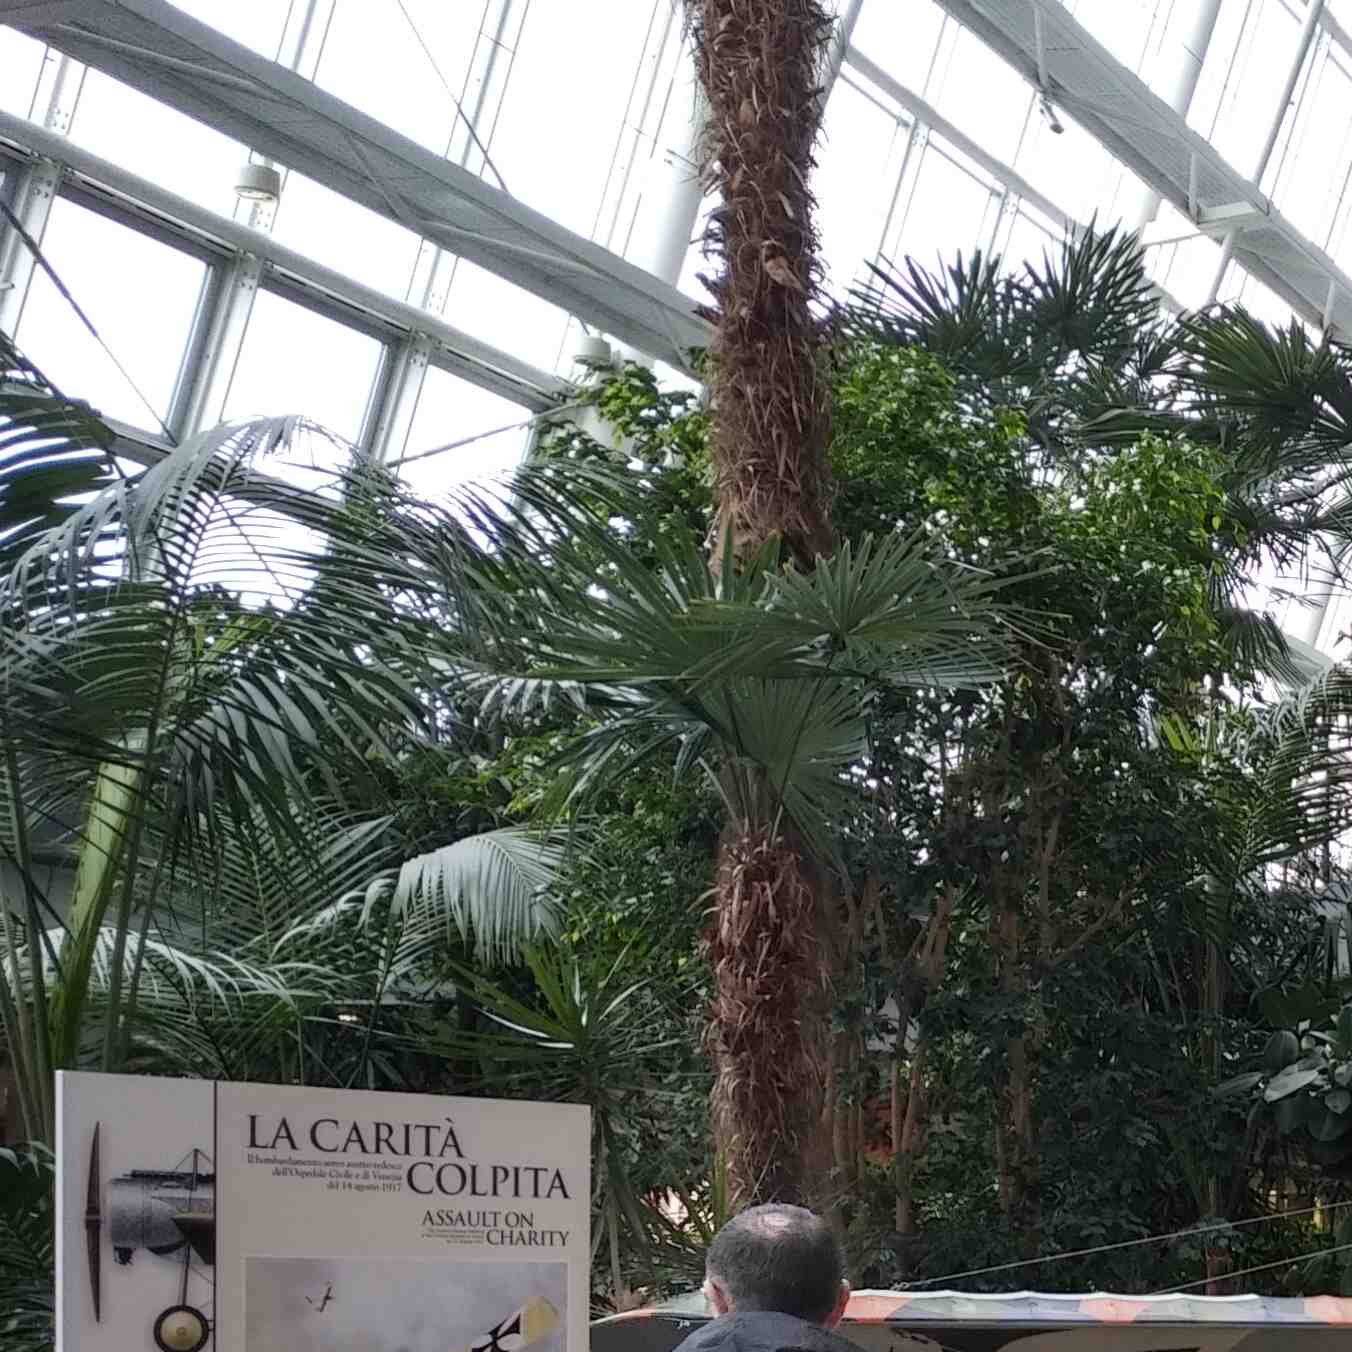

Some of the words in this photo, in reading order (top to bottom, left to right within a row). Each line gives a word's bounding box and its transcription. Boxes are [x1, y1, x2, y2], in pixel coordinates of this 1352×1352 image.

[247, 1114, 300, 1151] LA
[310, 1117, 465, 1158] CARITÀ
[406, 1162, 572, 1199] COLPITA
[421, 1210, 502, 1228] ASSAULT
[505, 1212, 534, 1229] ON
[486, 1229, 570, 1247] CHARITY
